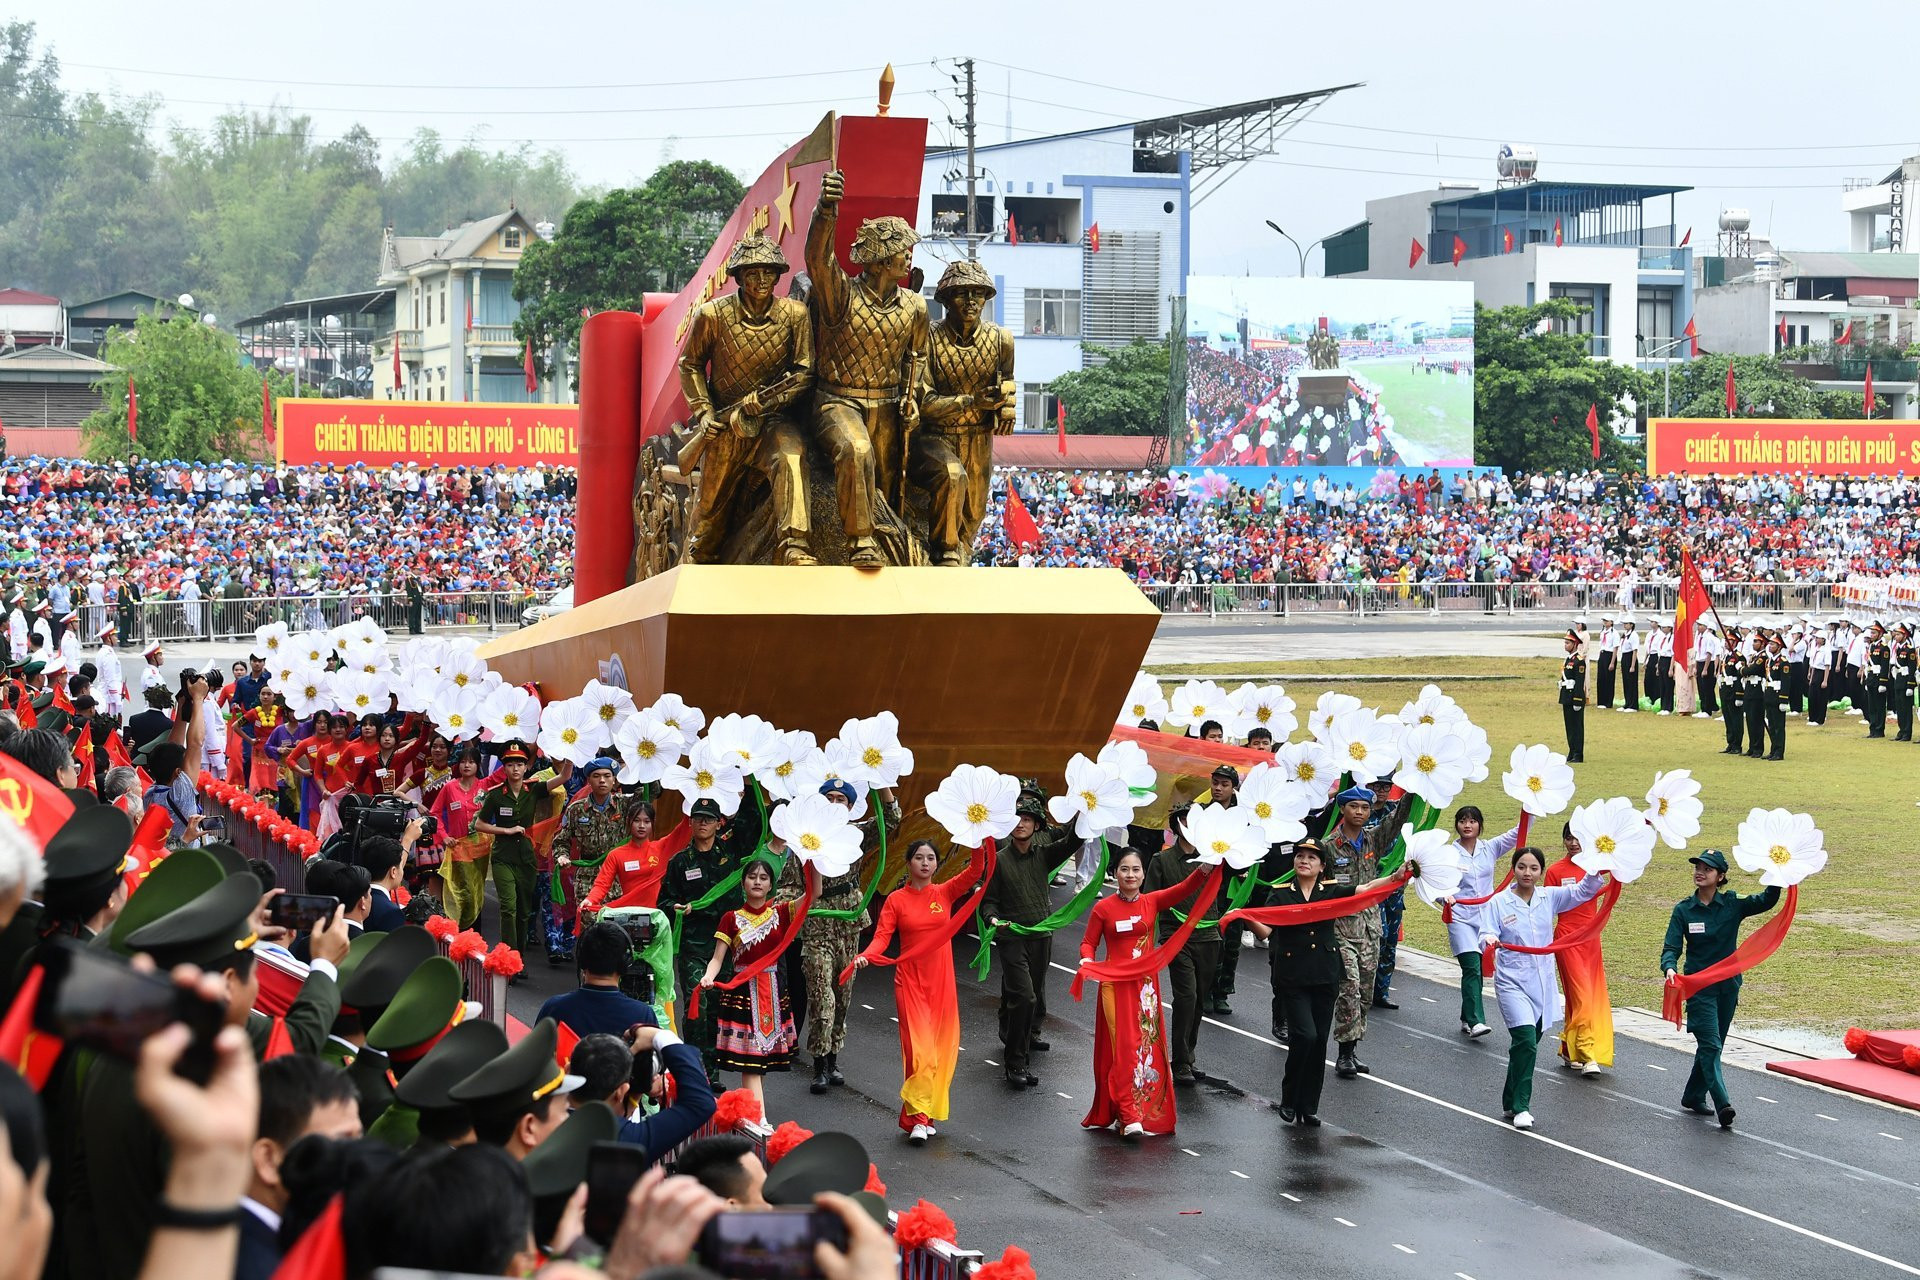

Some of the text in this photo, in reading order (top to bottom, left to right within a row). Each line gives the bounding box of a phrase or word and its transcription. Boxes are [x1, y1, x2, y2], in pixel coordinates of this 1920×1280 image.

[315, 415, 356, 452] CHIẾN
[360, 414, 406, 453] THẮNG
[410, 420, 444, 459] ĐIỆN
[447, 420, 481, 453] BIÊN
[485, 417, 514, 453] PHỦ
[528, 421, 565, 454] LỪNG
[1685, 432, 1730, 463] CHIẾN
[1734, 430, 1783, 464] THẮNG
[1786, 435, 1822, 469] ĐIỆN
[1826, 435, 1861, 464] BIÊN
[1866, 432, 1896, 464] PHỦ
